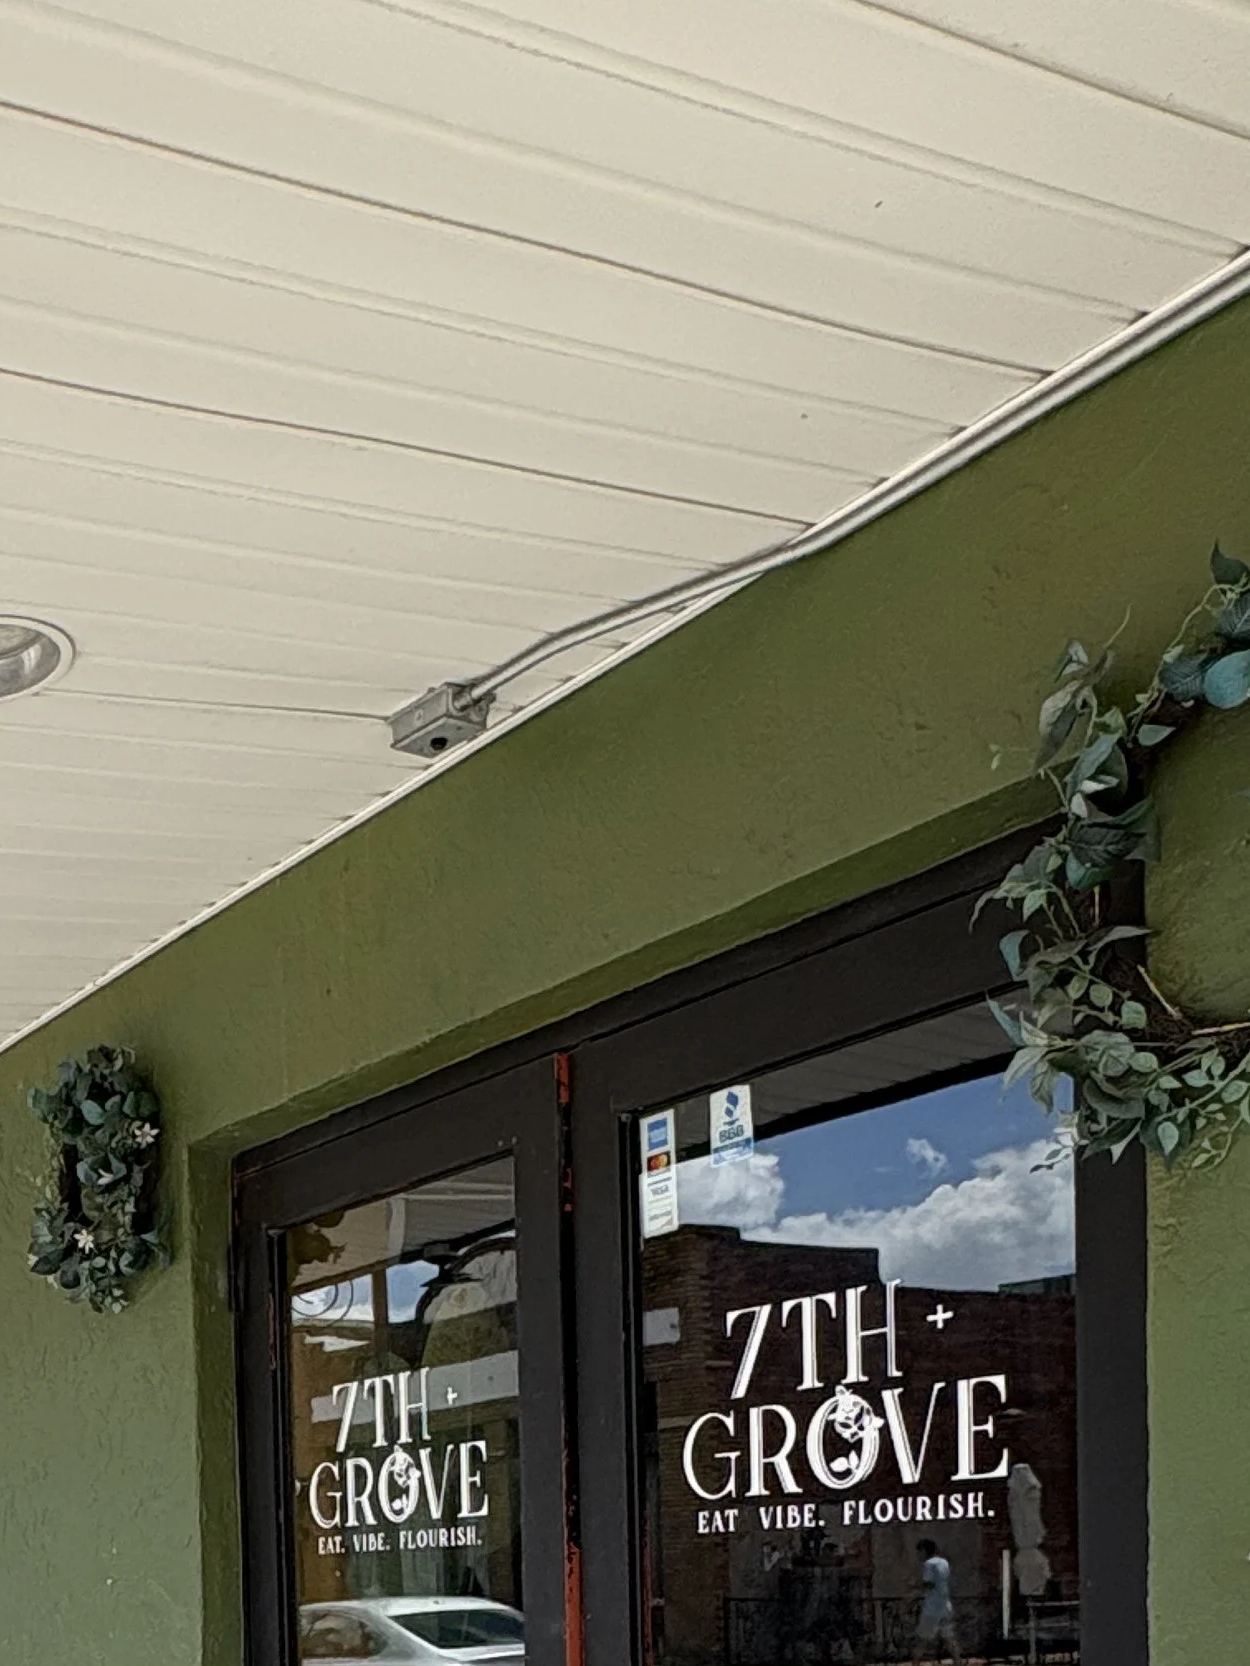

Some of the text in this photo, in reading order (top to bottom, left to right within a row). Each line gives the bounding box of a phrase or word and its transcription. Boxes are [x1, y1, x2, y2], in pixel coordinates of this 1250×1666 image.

[725, 1278, 903, 1400] 7TH
[332, 1367, 431, 1452] 7TH
[682, 1374, 1009, 1500] GROVE
[310, 1440, 489, 1529] GROVE
[698, 1492, 996, 1534] EAT VIBE. FLOURISH.
[318, 1525, 483, 1556] EAT. VIBE. FLOURISH.
